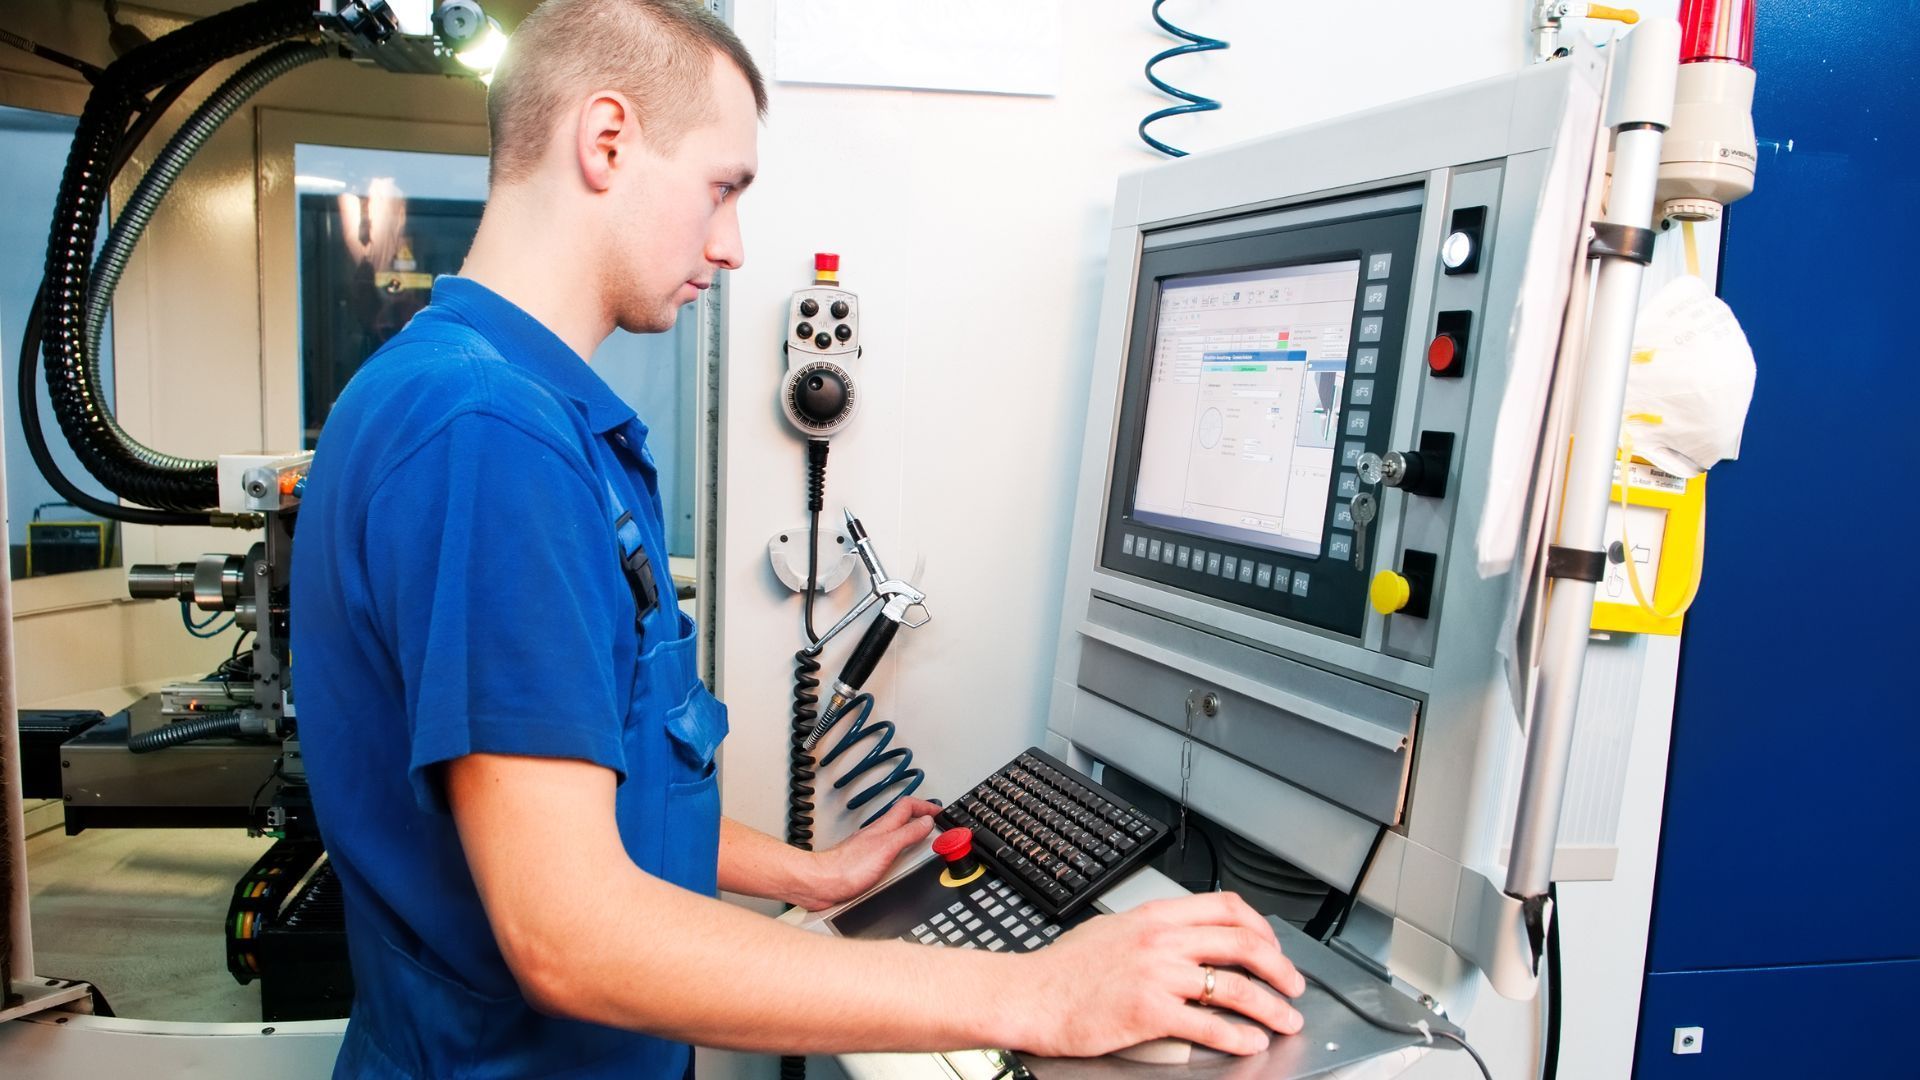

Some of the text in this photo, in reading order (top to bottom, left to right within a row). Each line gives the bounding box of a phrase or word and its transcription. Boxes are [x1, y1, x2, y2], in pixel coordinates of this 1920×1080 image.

[1373, 261, 1386, 272] sF1
[1368, 292, 1383, 303] sF2
[1364, 324, 1378, 335] sF3
[1360, 355, 1374, 366] sF4
[1355, 387, 1369, 397] sF5
[1351, 418, 1365, 429] sF6
[1346, 449, 1360, 459] sF7
[1338, 511, 1351, 522] sF9
[1331, 542, 1349, 553] sF10
[1210, 559, 1217, 568] F7
[1226, 562, 1234, 573] F8
[1242, 566, 1251, 576] F9
[1258, 570, 1270, 580] F10
[1276, 574, 1288, 585] F11
[1294, 578, 1308, 590] F12
